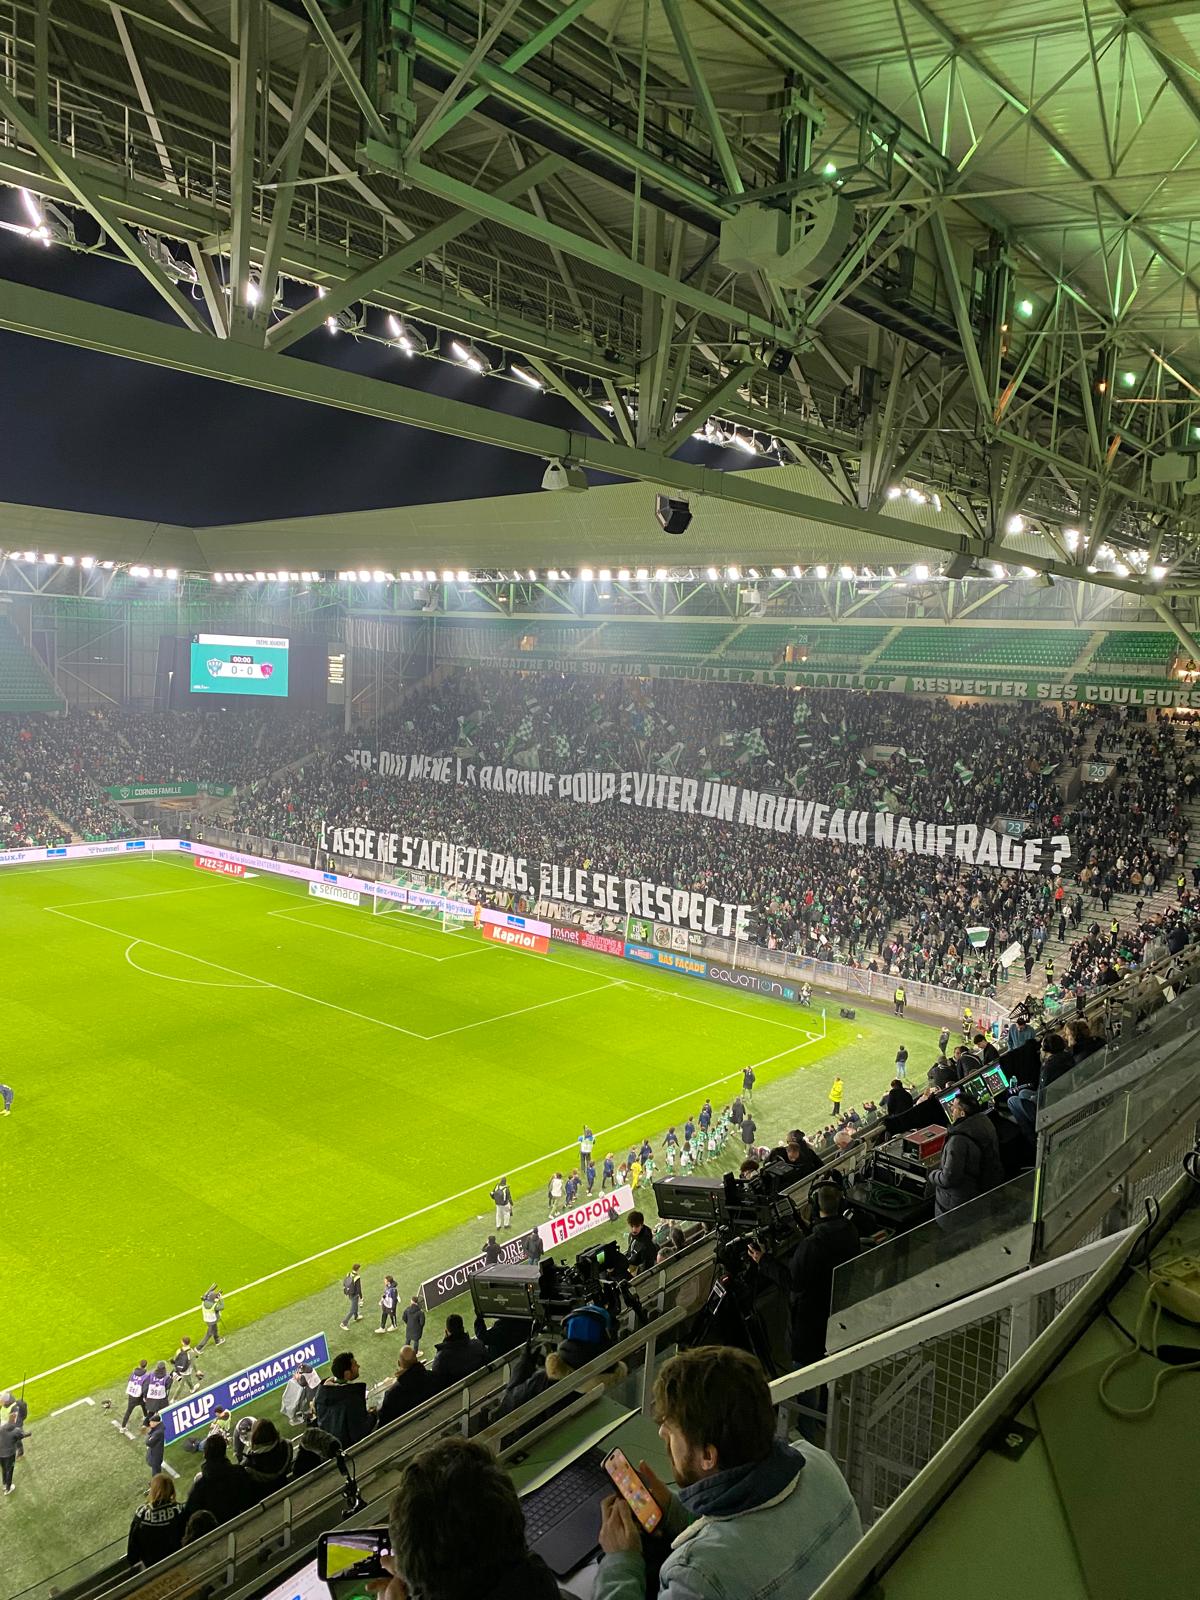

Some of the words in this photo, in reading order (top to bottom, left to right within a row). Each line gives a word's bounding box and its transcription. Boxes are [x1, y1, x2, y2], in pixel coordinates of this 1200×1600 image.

[231, 666, 238, 675] 0
[247, 666, 253, 675] 0
[480, 656, 544, 670] COMBATTRE
[548, 660, 577, 673] POUR
[583, 661, 605, 674] SON
[610, 663, 641, 676] CLUB
[659, 666, 754, 683] MOUILLER
[763, 671, 786, 685] LE
[796, 672, 896, 690] MAILLOT
[912, 678, 1027, 697] RESPECTER
[1037, 684, 1078, 699] SES
[1085, 685, 1200, 707] COULEURS
[1090, 765, 1104, 777] 26
[134, 787, 158, 796] CORNER
[158, 787, 182, 795] FAMILLE
[408, 754, 452, 783] MENE
[559, 772, 615, 803] POUR
[620, 771, 698, 813] EVITER
[701, 781, 737, 821] UN
[739, 789, 868, 844] NOUVEAU
[875, 813, 1042, 871] NAUFRAGE
[1050, 835, 1071, 874] ?
[1008, 822, 1021, 835] 23
[96, 845, 120, 854] hummel
[377, 832, 398, 865] NE
[540, 862, 588, 903] ELLE
[593, 873, 620, 911] SE
[625, 878, 752, 941] RESPECTE
[493, 927, 536, 948] Kapriol
[567, 1194, 620, 1230] SOFODA
[437, 1256, 488, 1296] SOCIETY
[228, 1344, 316, 1398] FORMATION
[231, 1384, 266, 1406] Alternance
